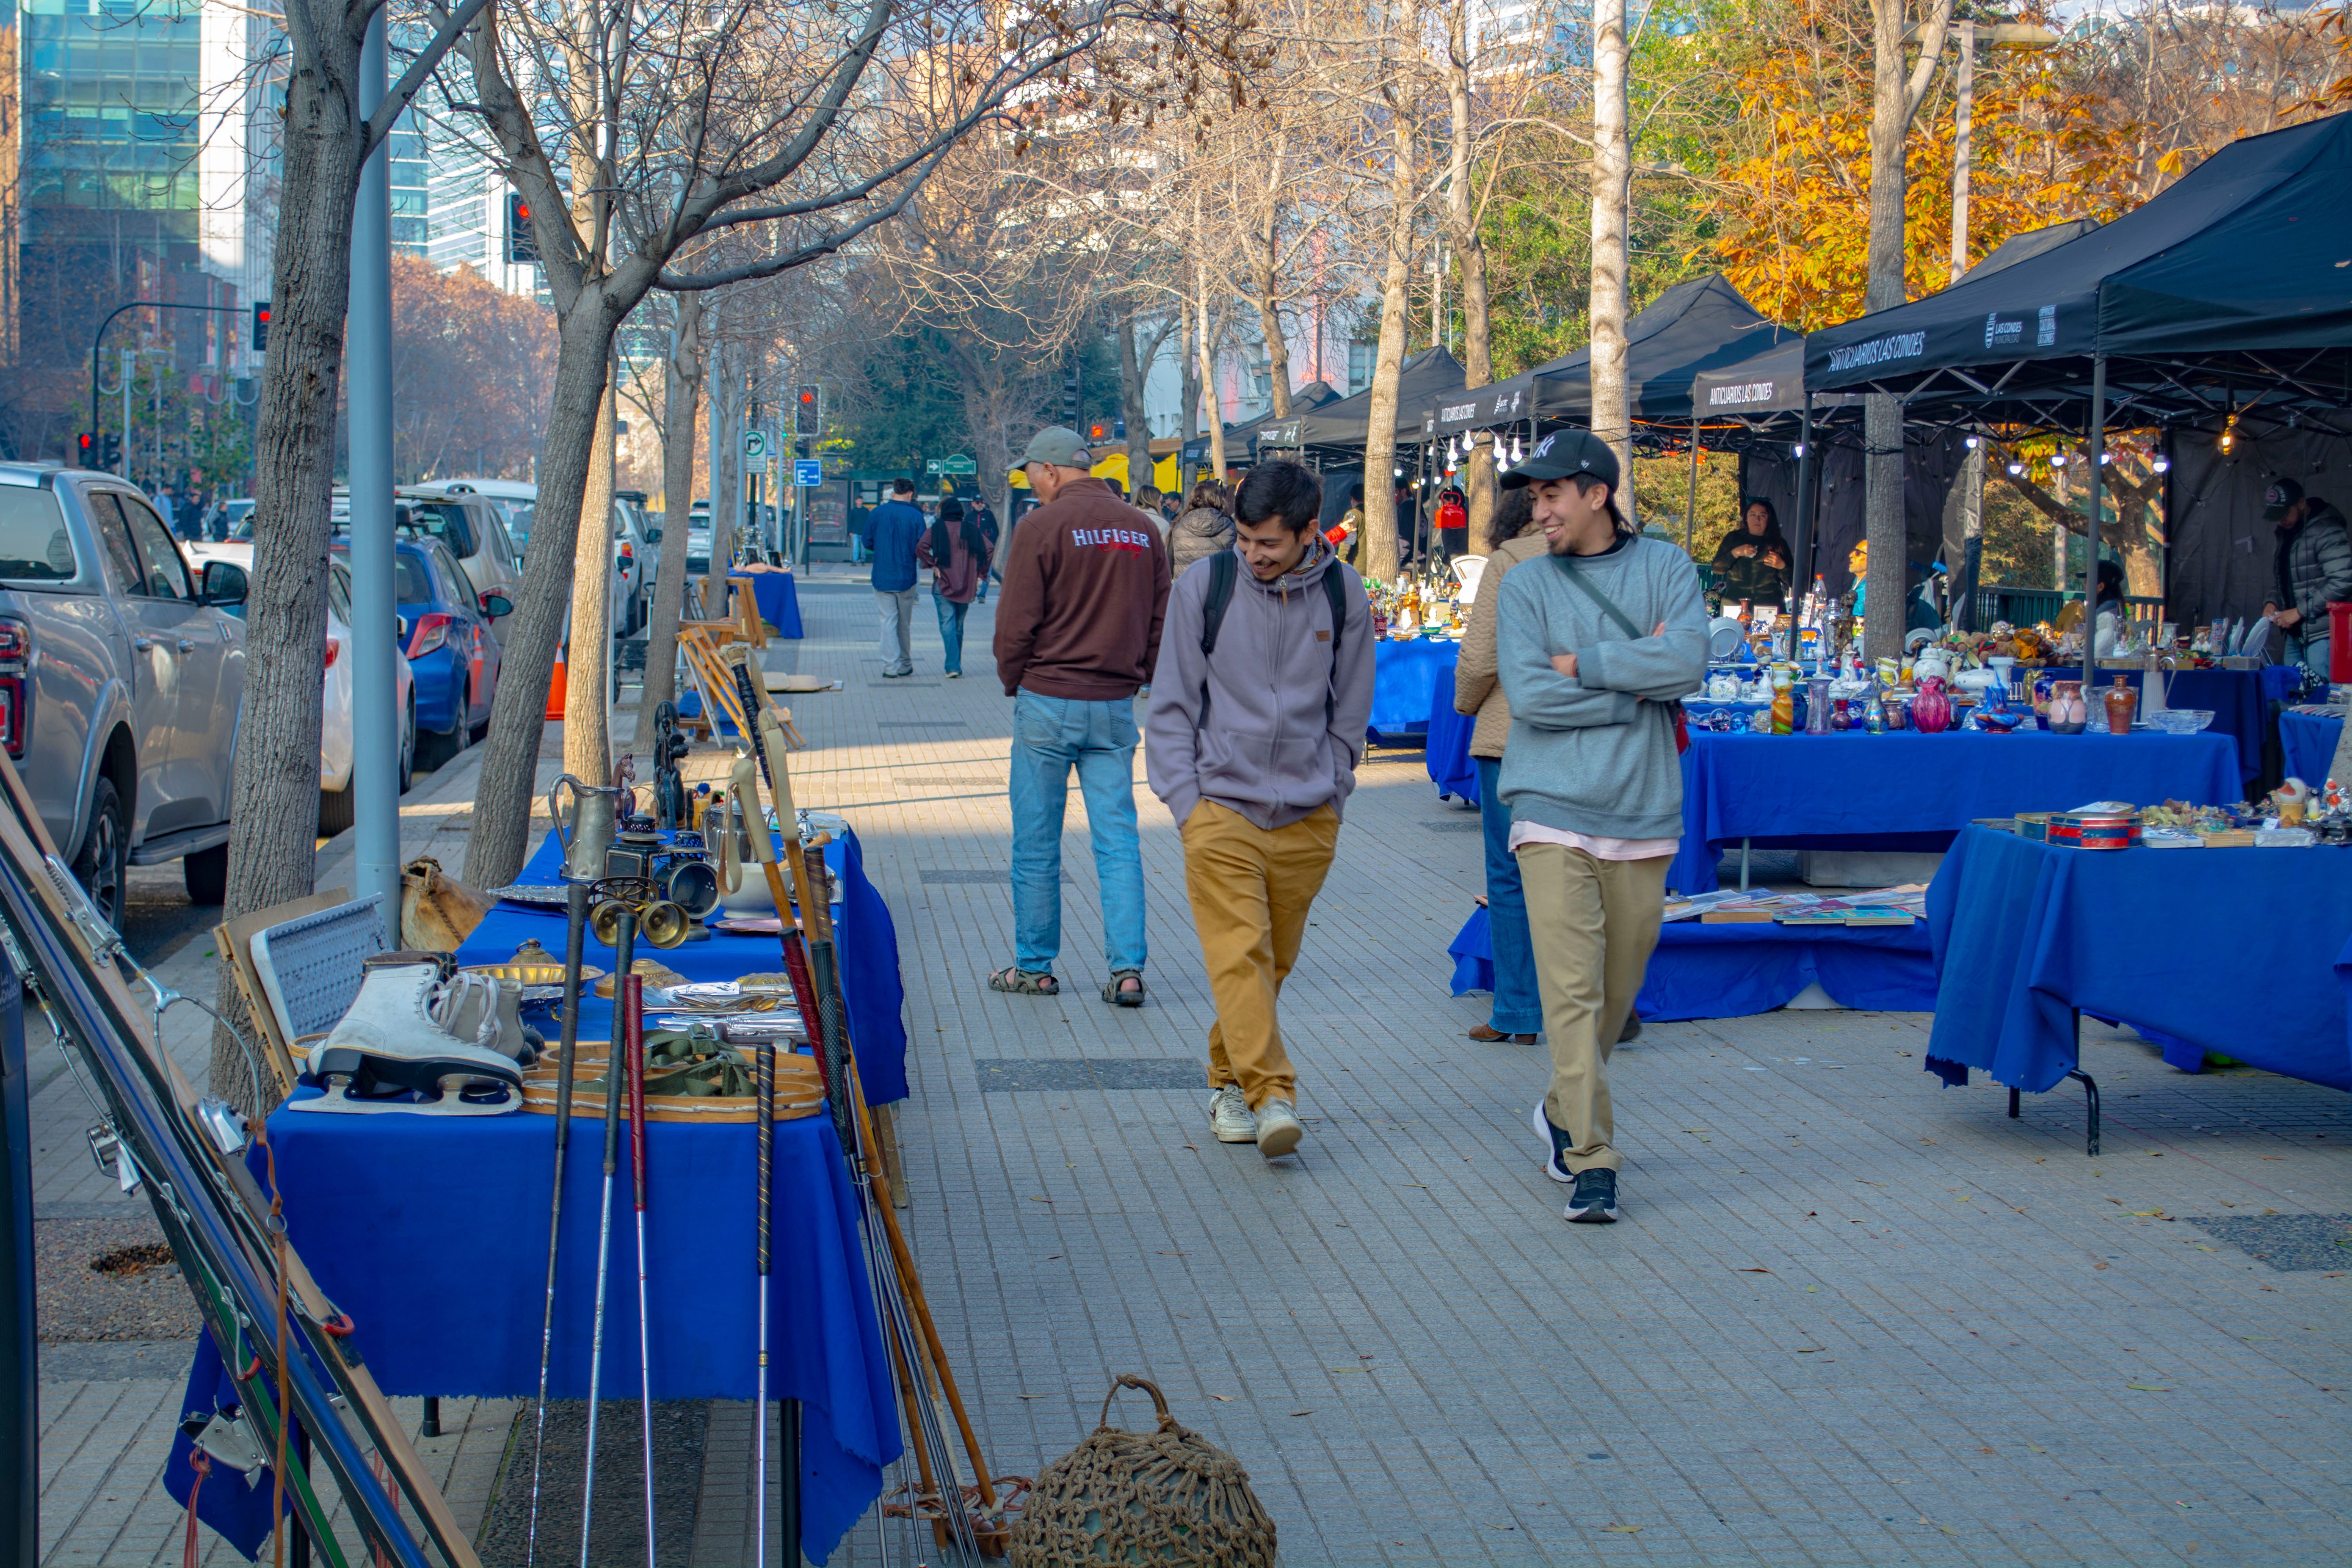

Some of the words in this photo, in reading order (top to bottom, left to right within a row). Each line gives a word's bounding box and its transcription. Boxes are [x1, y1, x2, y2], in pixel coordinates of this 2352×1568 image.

[1995, 323, 2004, 334] LAS
[2004, 321, 2022, 333] CONDES
[1994, 334, 2019, 344] MUNICIPALIDAD
[1828, 340, 1879, 372] ANTICUARIOS
[1878, 336, 1896, 362] LAS
[1893, 331, 1926, 359] CONDES
[1710, 385, 1742, 405] ANTICUARIOS
[1742, 384, 1752, 403] LAS
[1751, 382, 1773, 401] CONDES
[797, 470, 807, 483] E
[1071, 529, 1150, 548] HILFIGER
